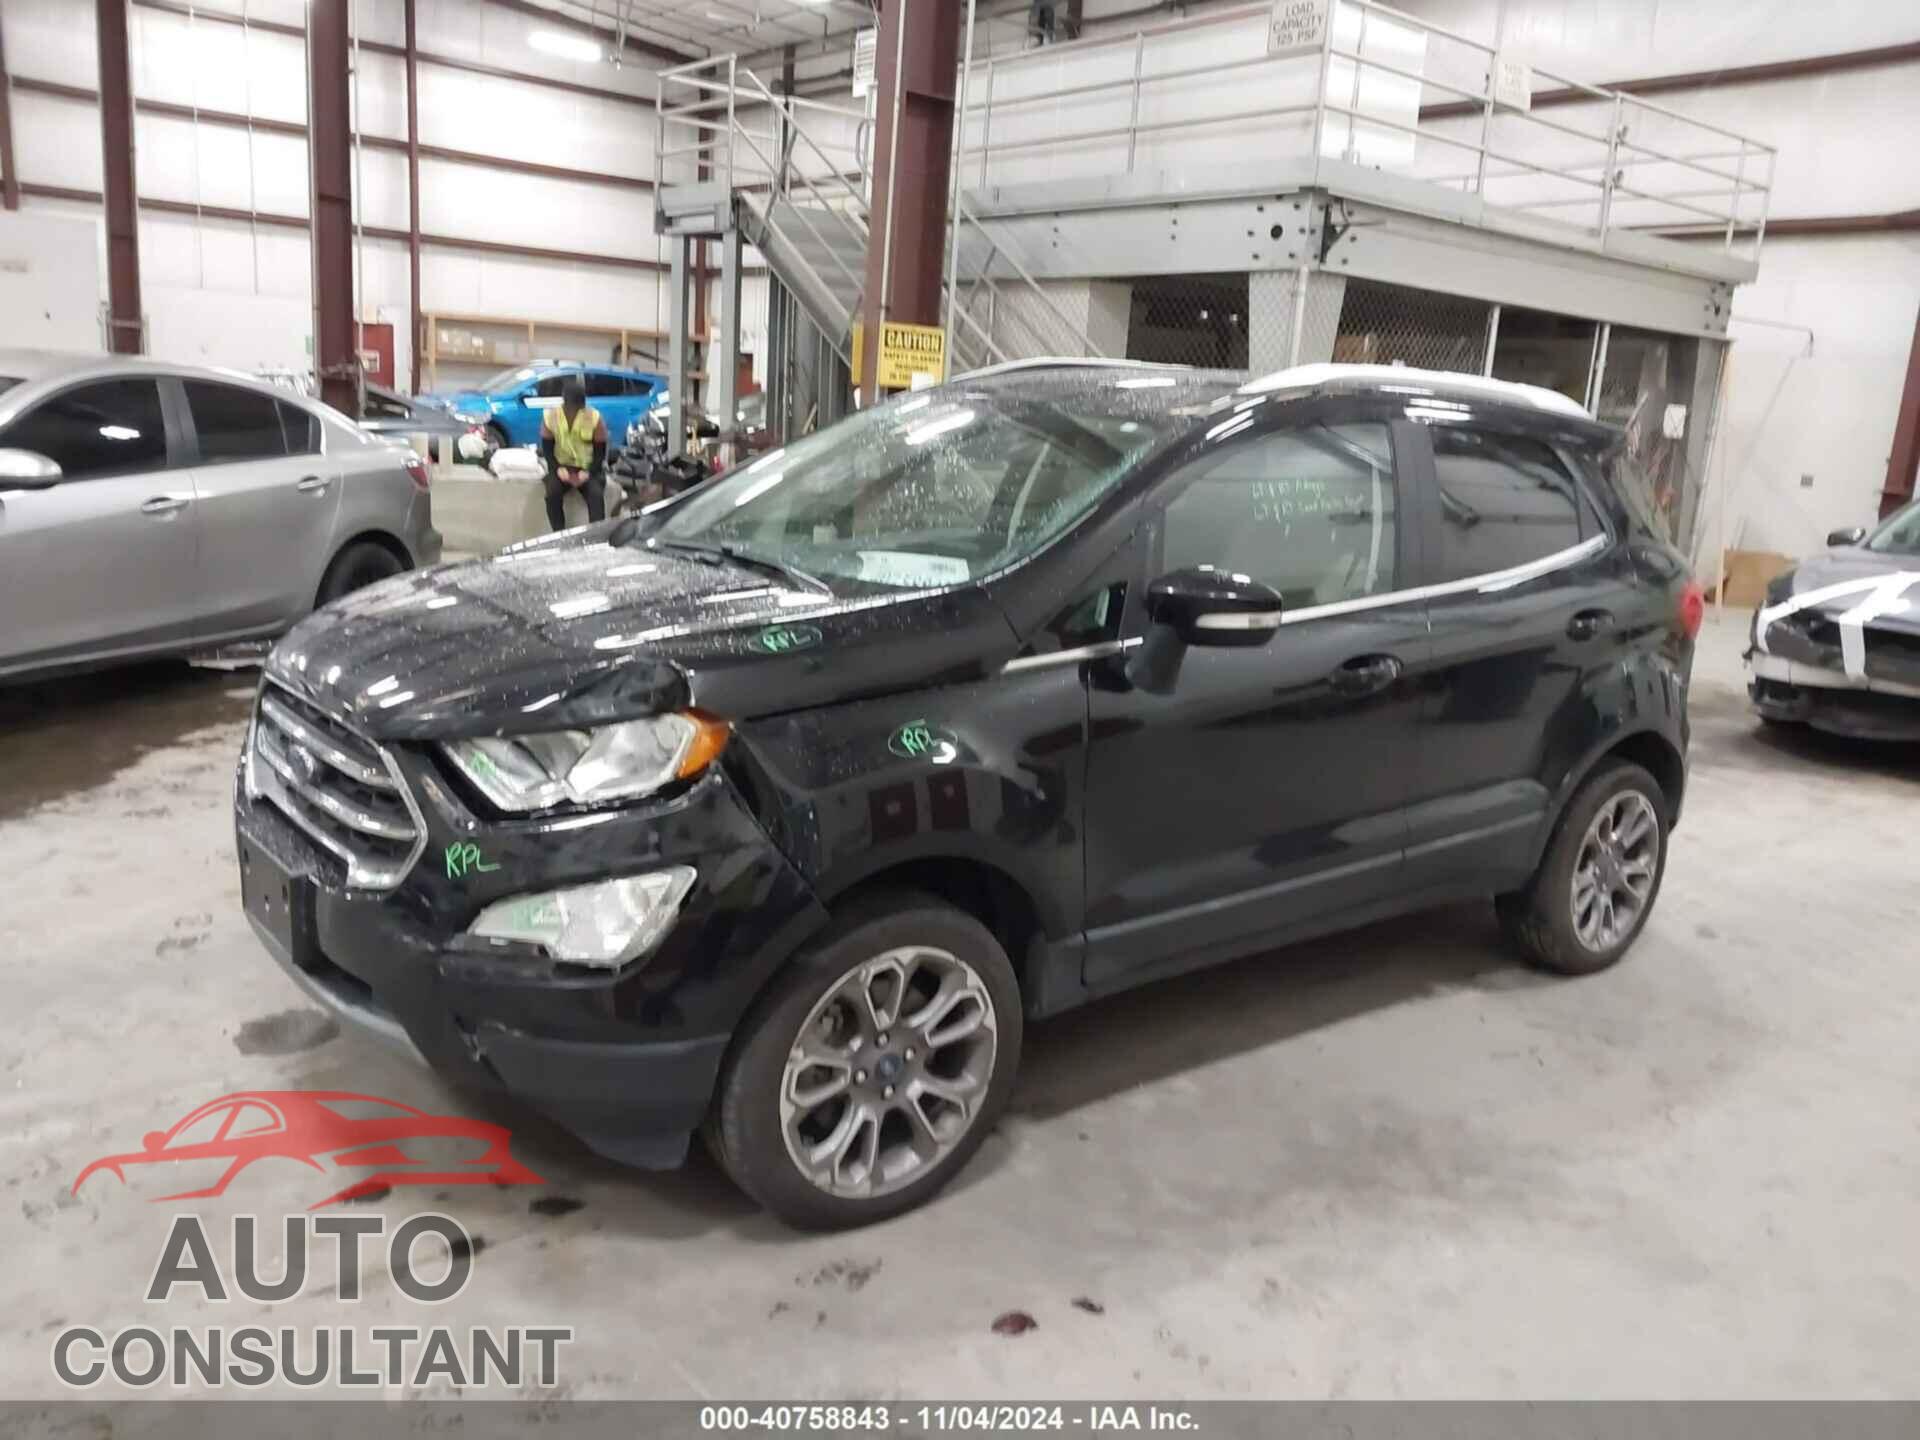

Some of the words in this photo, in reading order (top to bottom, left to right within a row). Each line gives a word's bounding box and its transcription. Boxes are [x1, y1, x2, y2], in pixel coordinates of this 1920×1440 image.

[1285, 2, 1314, 17] LOAD
[1273, 15, 1322, 32] CAPACITY
[885, 329, 941, 352] CAUTION
[445, 841, 501, 880] RPL
